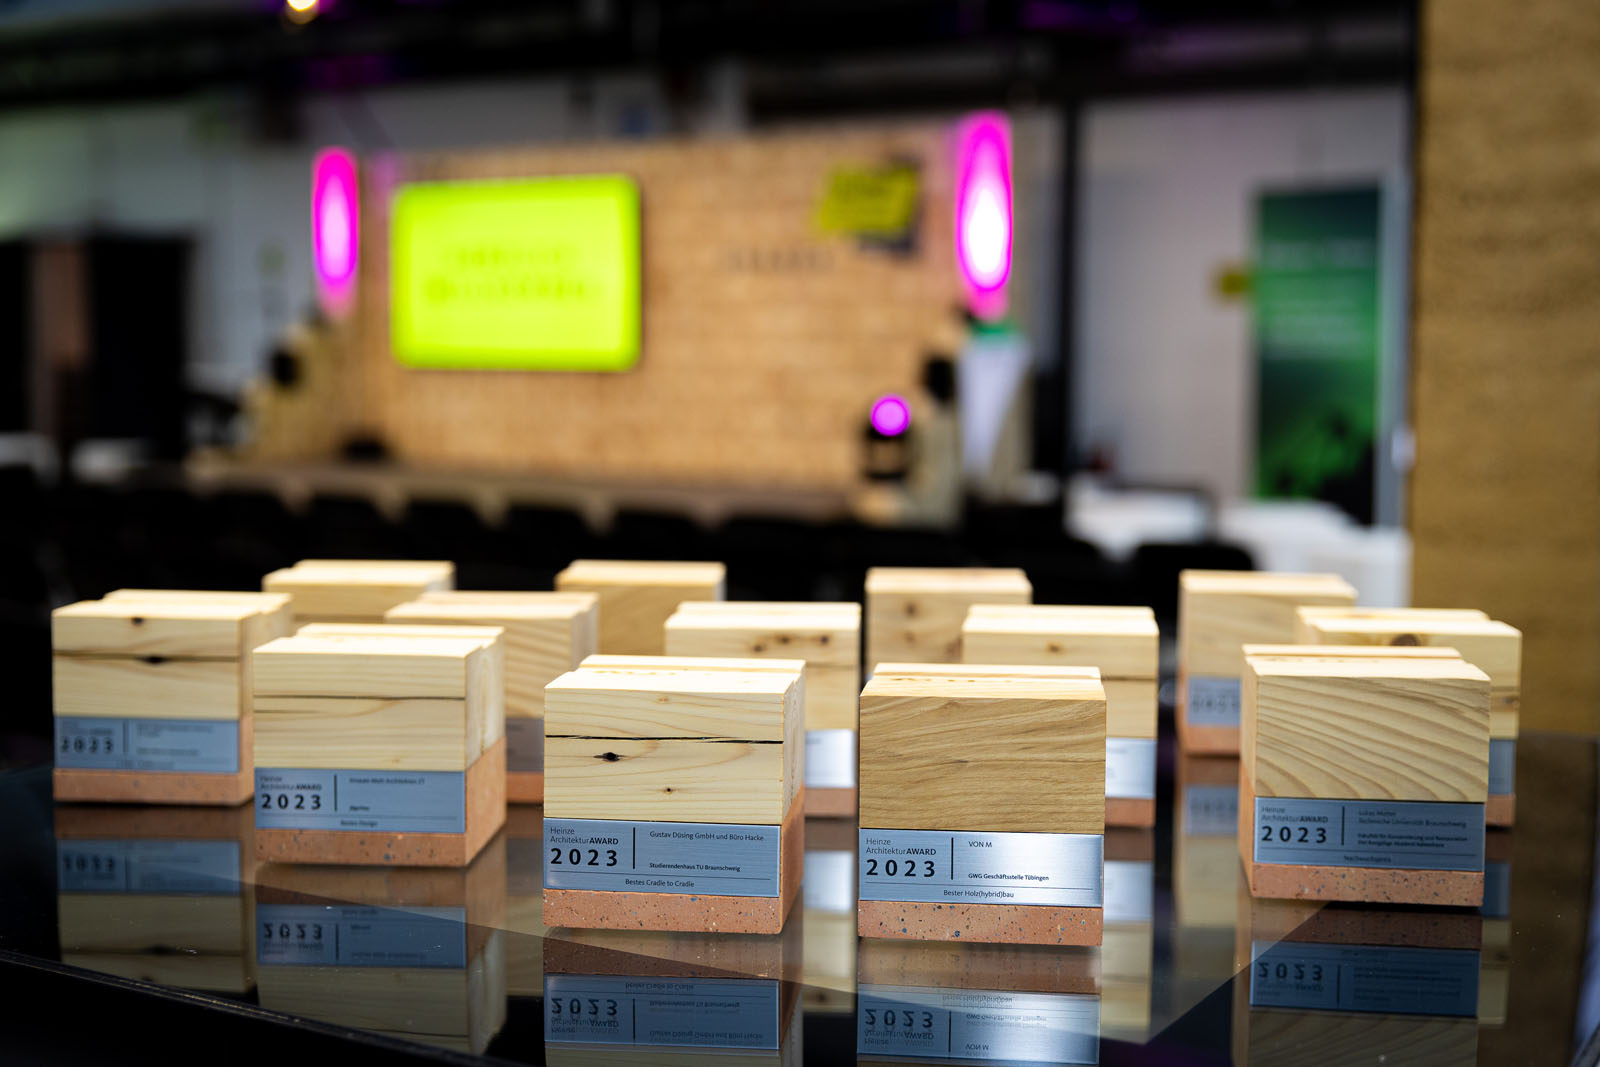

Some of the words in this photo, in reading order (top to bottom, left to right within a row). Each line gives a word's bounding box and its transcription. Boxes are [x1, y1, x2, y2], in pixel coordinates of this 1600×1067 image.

[261, 793, 321, 810] 2023
[550, 826, 575, 835] Heinze
[1261, 825, 1327, 843] 2023
[650, 831, 671, 839] Gustav
[672, 831, 693, 840] Düsing
[550, 836, 619, 845] ArchitekturAWARD
[866, 847, 936, 856] ArchitekturAWARD
[550, 847, 618, 867] 2023
[705, 864, 740, 872] Braunschweig
[866, 859, 935, 878] 2023
[646, 879, 665, 887] Cradle
[675, 880, 694, 888] Cradle
[965, 890, 1014, 898] Holz(hybrid)bau
